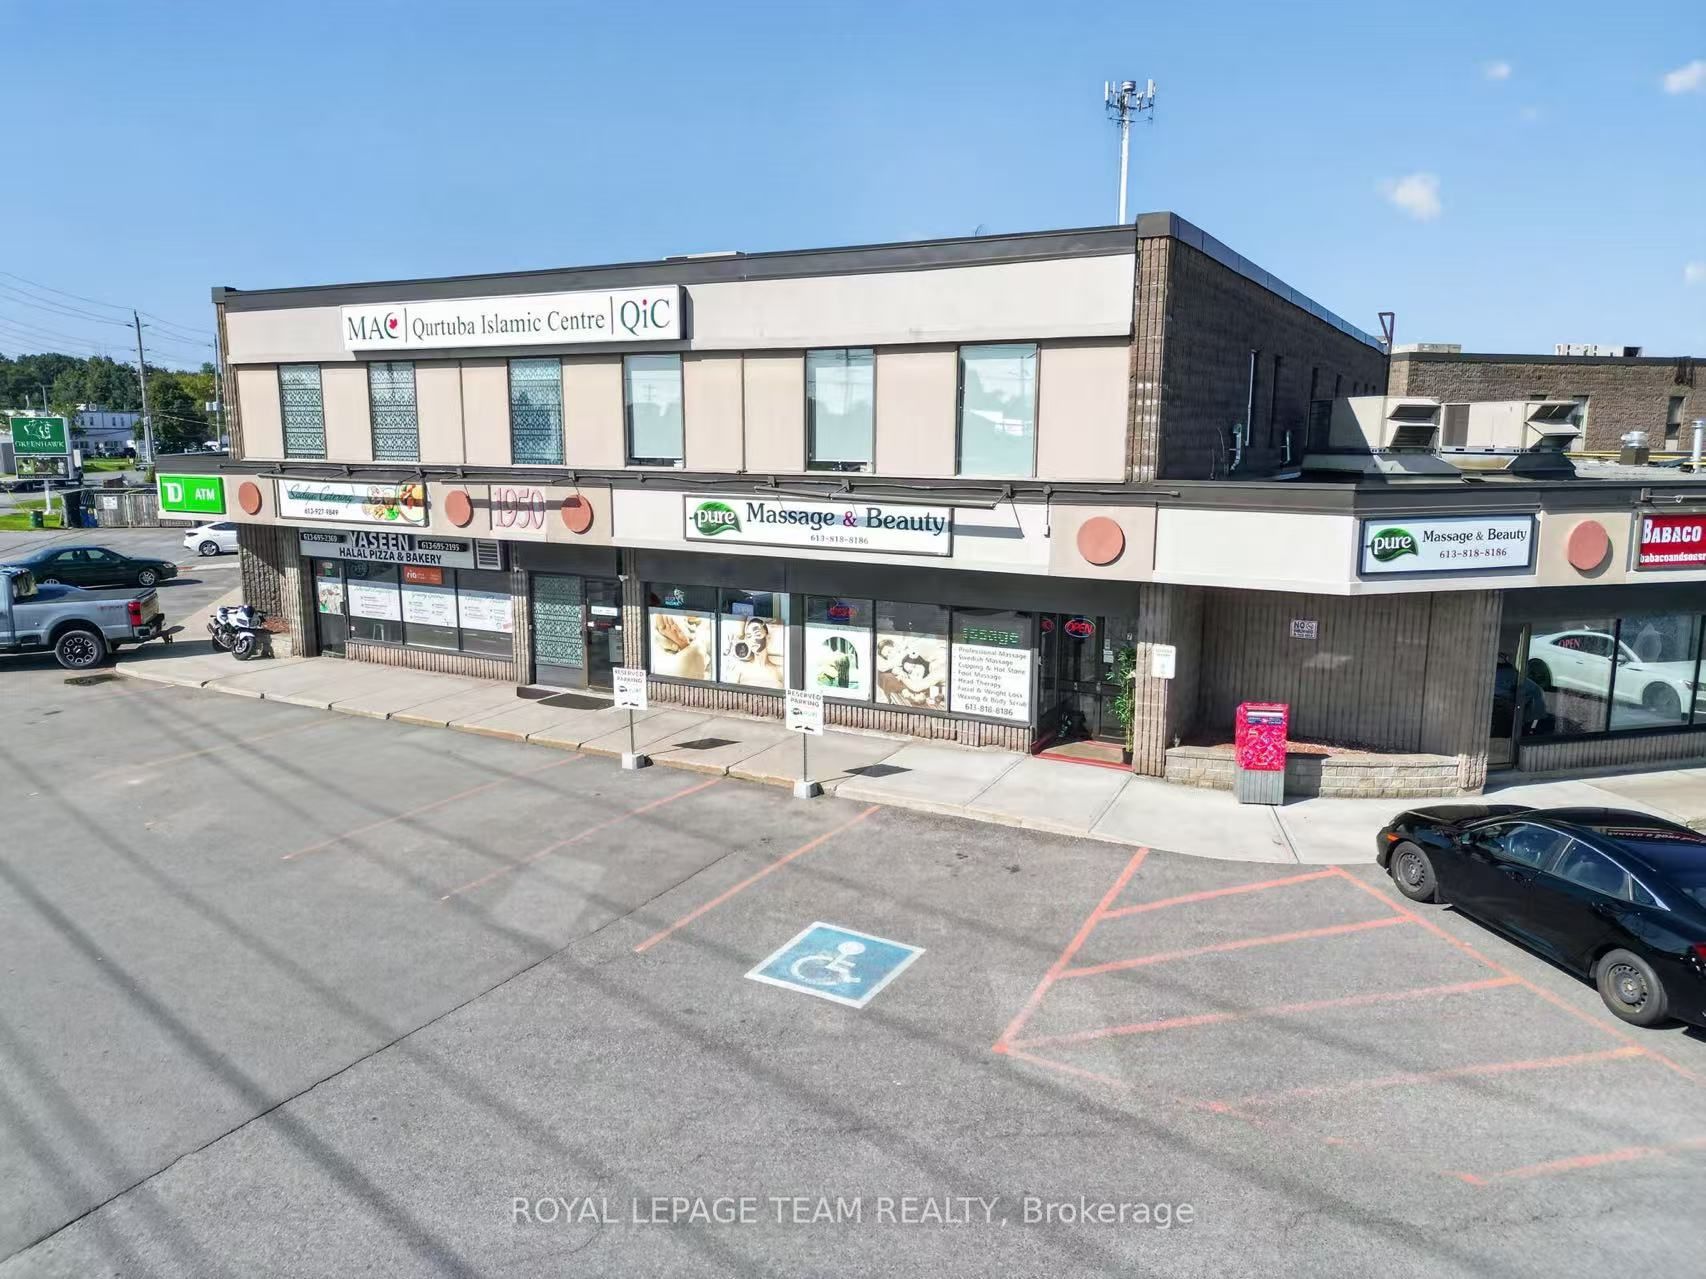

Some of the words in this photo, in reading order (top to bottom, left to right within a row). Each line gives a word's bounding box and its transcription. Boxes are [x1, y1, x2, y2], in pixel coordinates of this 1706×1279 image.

[347, 311, 400, 341] MAC
[412, 317, 476, 342] Qurtuba
[481, 313, 541, 335] Islamic
[547, 309, 605, 331] Centre
[620, 298, 671, 337] QiC
[15, 440, 65, 448] GREENHAWK
[162, 482, 183, 503] TD
[194, 488, 215, 501] ATM
[495, 487, 545, 529] 1950
[695, 508, 736, 527] pure
[746, 502, 835, 530] Massage
[842, 511, 857, 528] &
[865, 507, 945, 536] Beauty
[1641, 519, 1702, 544] BABACO
[348, 531, 409, 551] YASEEN
[810, 534, 869, 545] 613-818-8186
[1373, 535, 1412, 555] pure
[1422, 530, 1474, 544] Massage
[1475, 531, 1484, 540] &
[1487, 528, 1527, 542] Beauty
[339, 547, 367, 558] HALAL
[369, 549, 395, 561] PIZZA
[397, 552, 404, 561] &
[406, 553, 442, 564] BAKERY
[1439, 547, 1507, 559] 613-818-8186
[1066, 621, 1093, 633] OPEN
[1558, 638, 1580, 649] OPEN
[959, 647, 997, 655] Professional
[999, 651, 1026, 659] Massage
[958, 655, 984, 663] Swedish
[985, 657, 1013, 667] Massage
[958, 662, 984, 671] Cupping
[614, 669, 644, 677] RESERVED
[974, 671, 1001, 680] Massage
[976, 679, 1001, 688] Therapy
[787, 689, 821, 700] RESERVED
[791, 697, 820, 707] PARKING
[965, 703, 1013, 716] 613-818-8186
